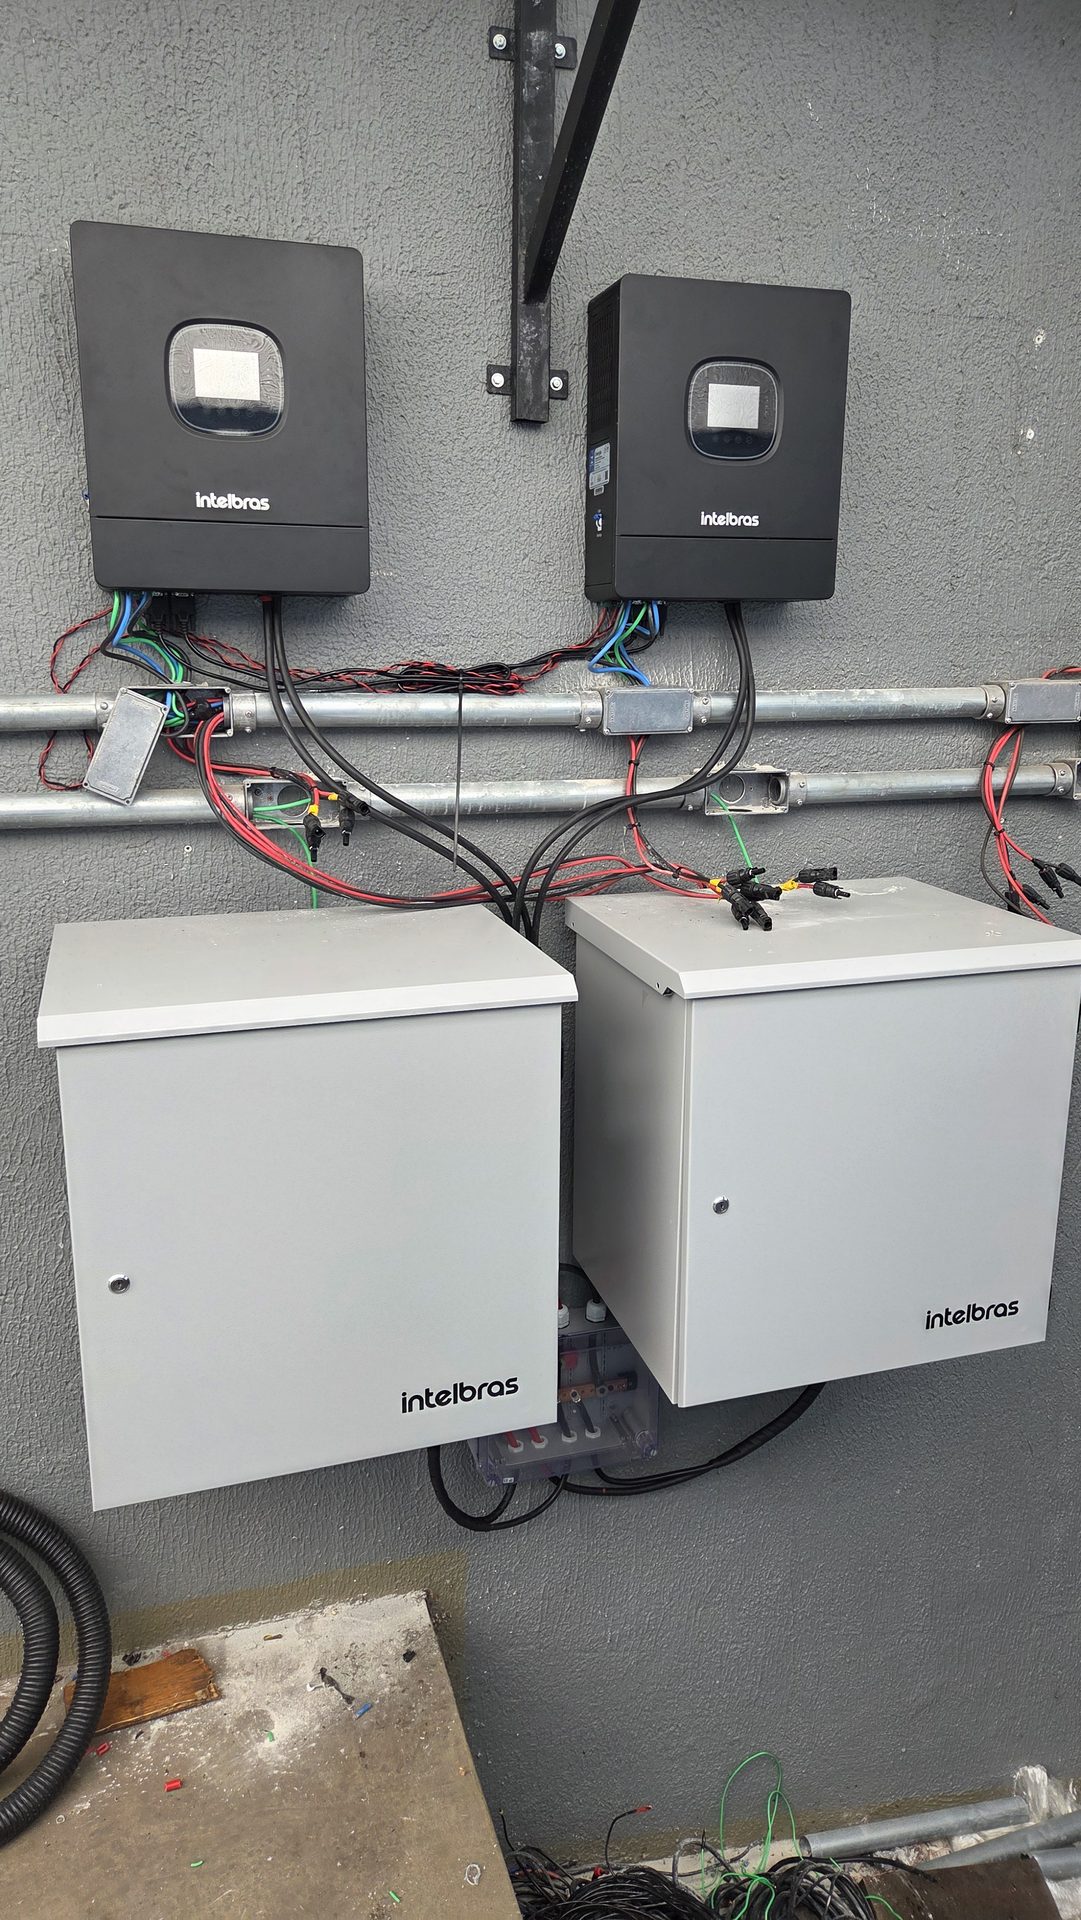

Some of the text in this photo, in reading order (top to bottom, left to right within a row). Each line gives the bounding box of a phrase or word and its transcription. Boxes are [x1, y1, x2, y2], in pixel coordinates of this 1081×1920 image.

[195, 491, 270, 511] intelbras
[700, 511, 760, 527] intelbras
[925, 1300, 1019, 1330] intelbras
[401, 1377, 519, 1414] intelbras
